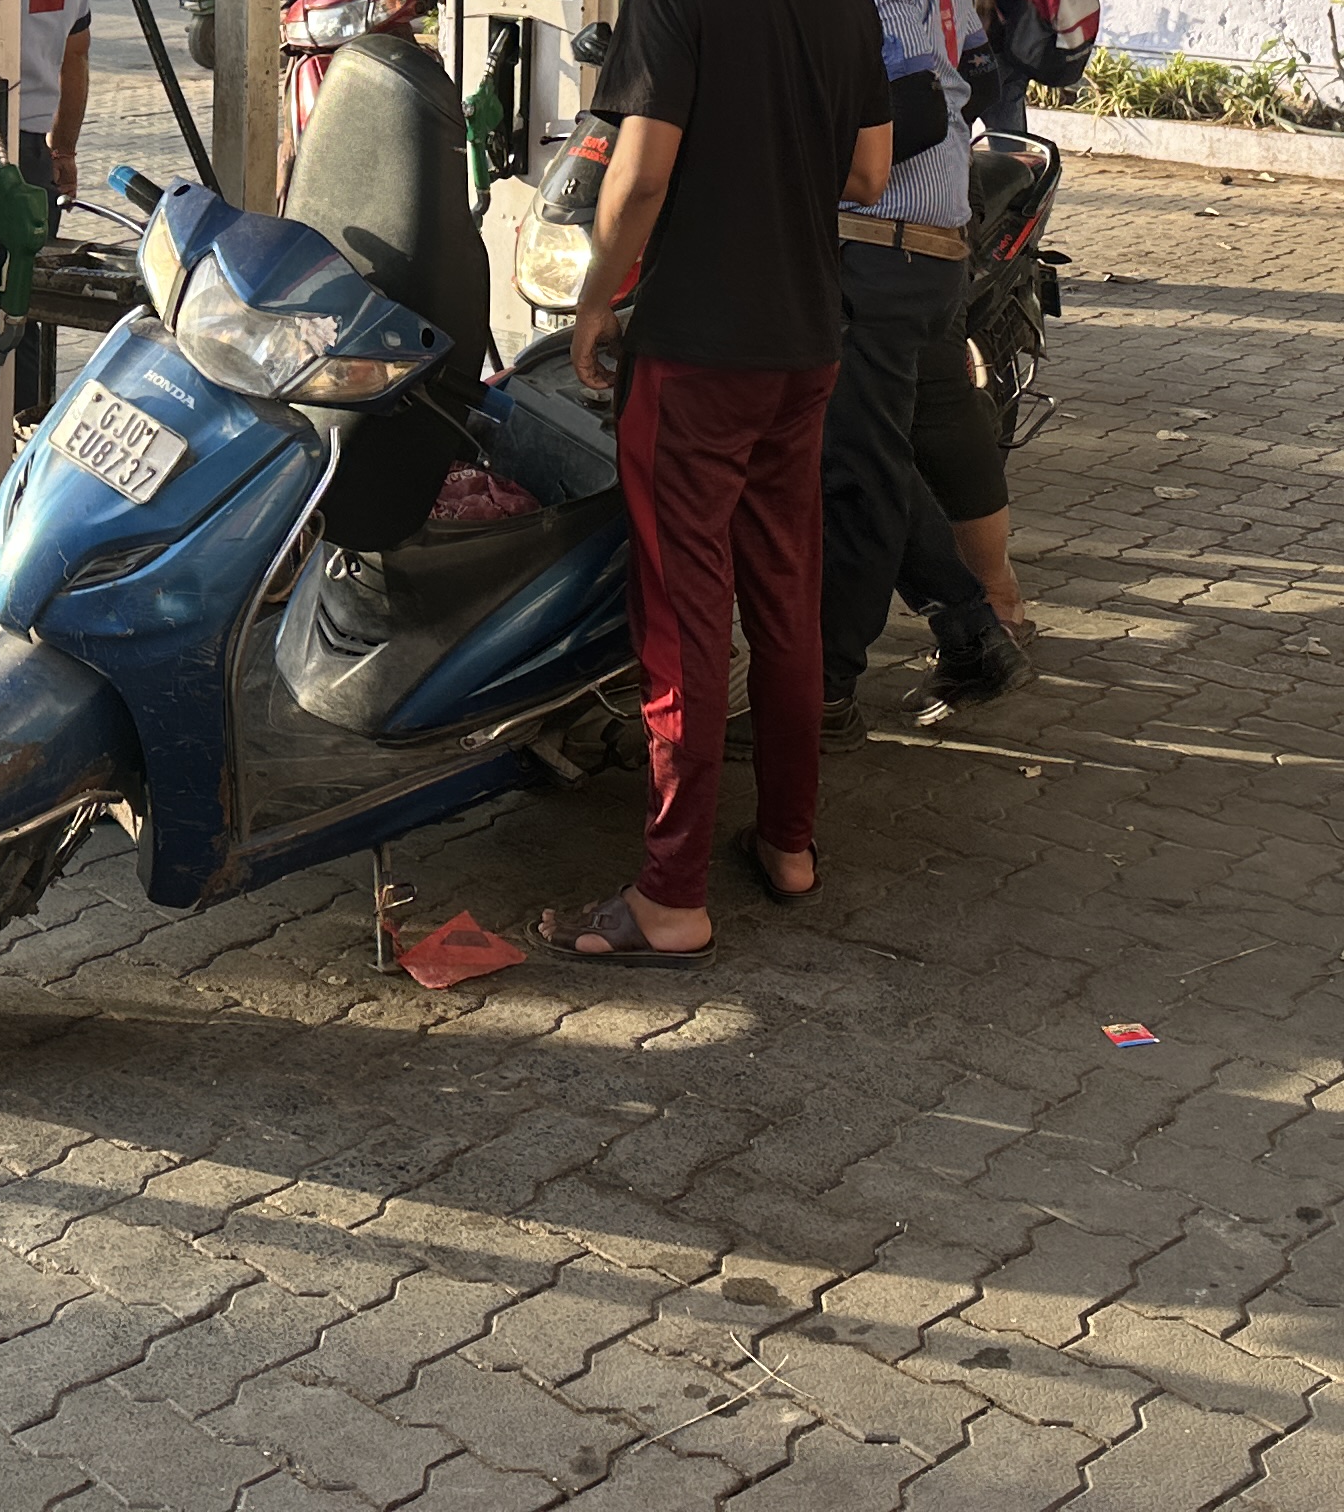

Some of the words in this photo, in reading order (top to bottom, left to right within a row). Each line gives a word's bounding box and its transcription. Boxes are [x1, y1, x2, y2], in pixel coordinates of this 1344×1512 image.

[143, 369, 196, 410] HONDA
[100, 402, 159, 456] GJ01
[65, 421, 157, 493] EU8737
